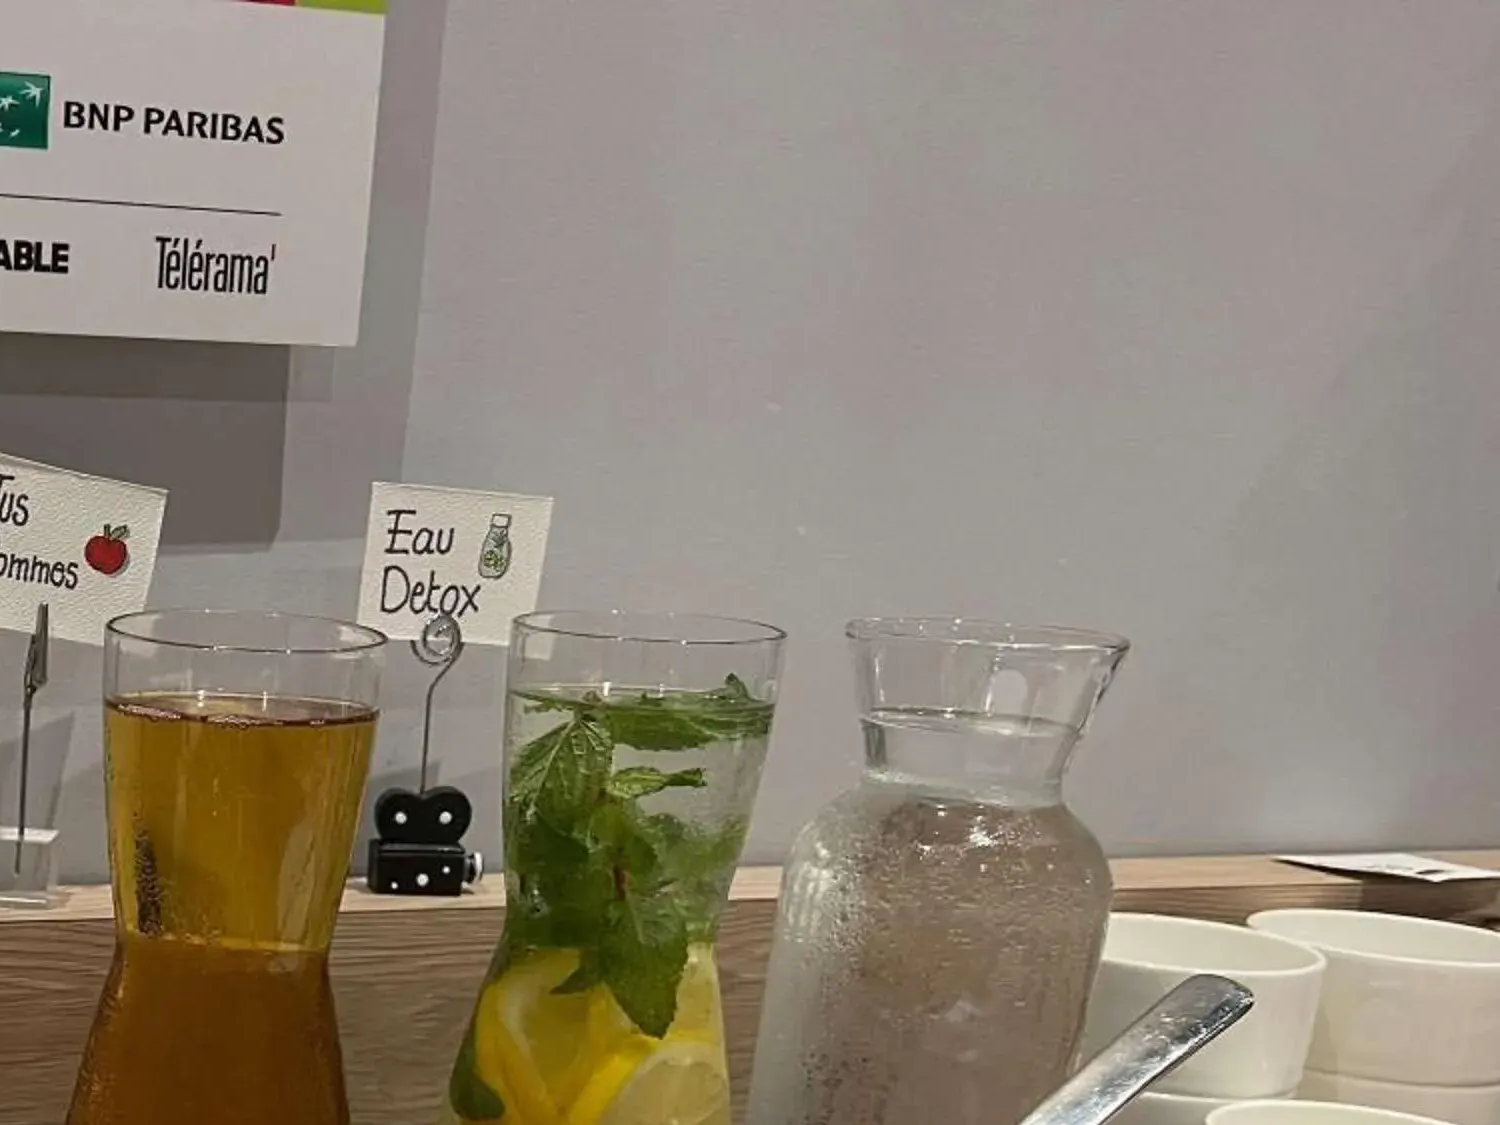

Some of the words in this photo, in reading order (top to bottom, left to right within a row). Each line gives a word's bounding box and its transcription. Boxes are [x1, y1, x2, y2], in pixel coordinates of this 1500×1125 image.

[63, 101, 134, 132] BNP
[143, 107, 285, 145] PARIBAS
[385, 510, 455, 556] Eau
[379, 565, 481, 617] Detox
